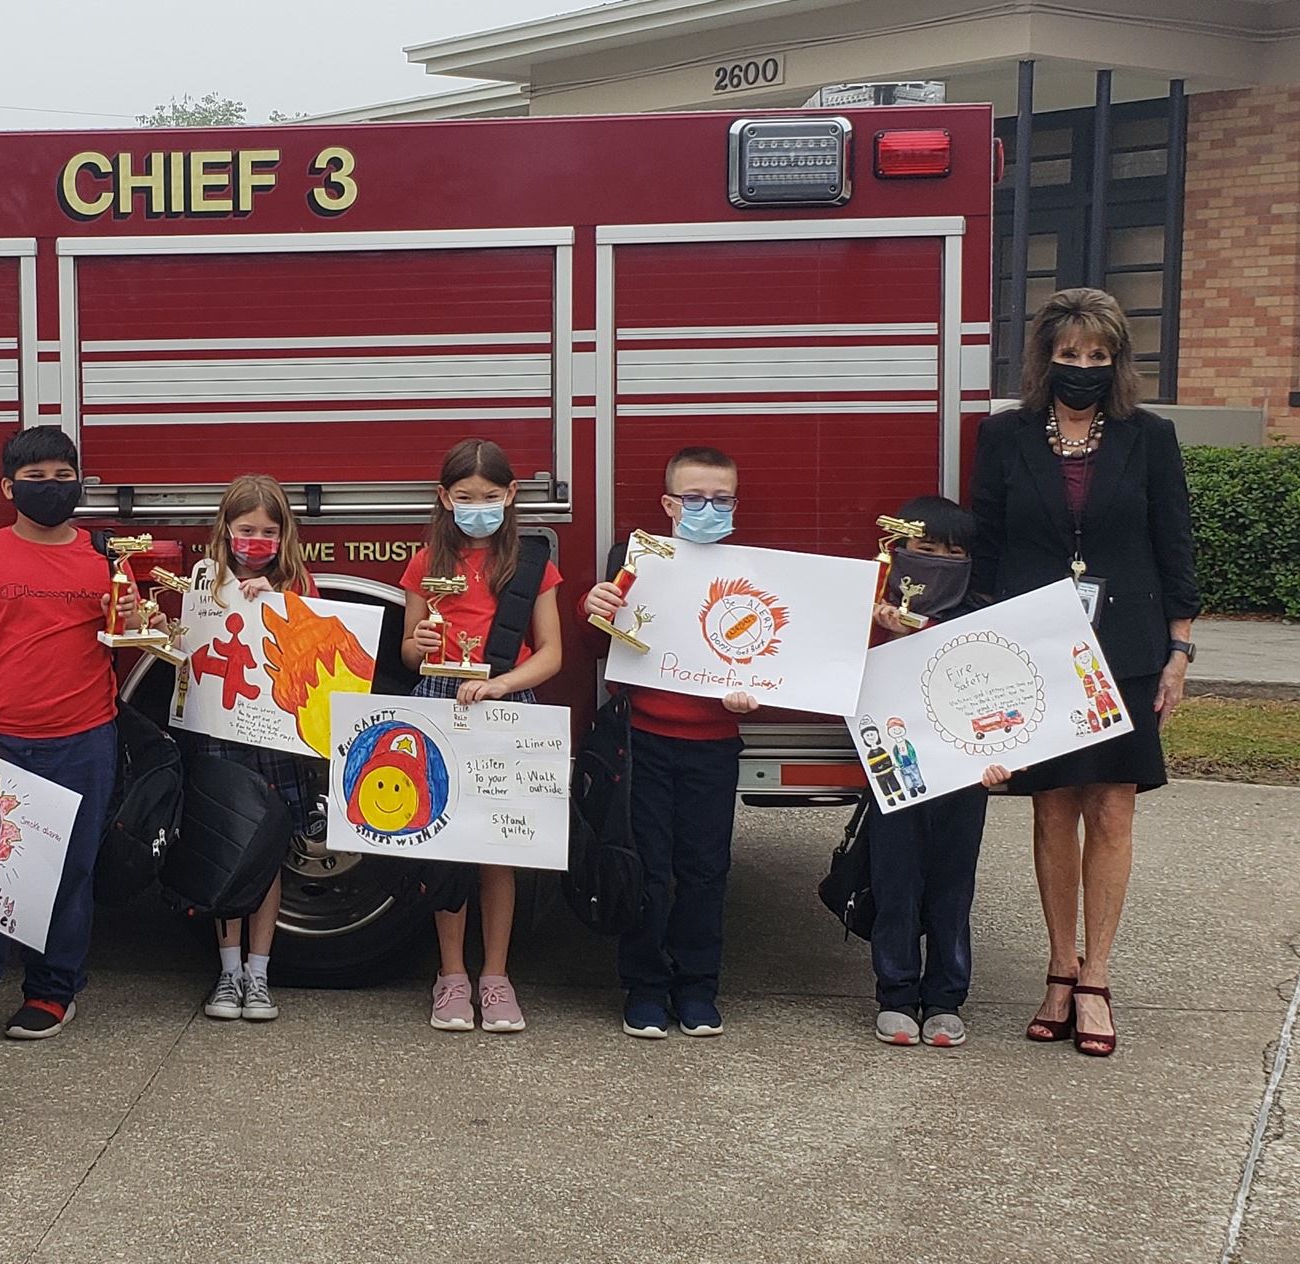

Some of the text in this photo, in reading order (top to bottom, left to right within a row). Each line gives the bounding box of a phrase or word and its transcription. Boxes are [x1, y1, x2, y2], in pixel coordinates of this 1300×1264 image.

[714, 58, 779, 91] 2600
[60, 147, 359, 219] CHIEF 3
[299, 543, 335, 561] WE
[946, 664, 972, 681] Fire
[954, 672, 990, 692] Safety
[548, 739, 562, 750] up
[488, 775, 507, 787] your
[529, 783, 563, 794] outside
[477, 786, 508, 795] Teacher
